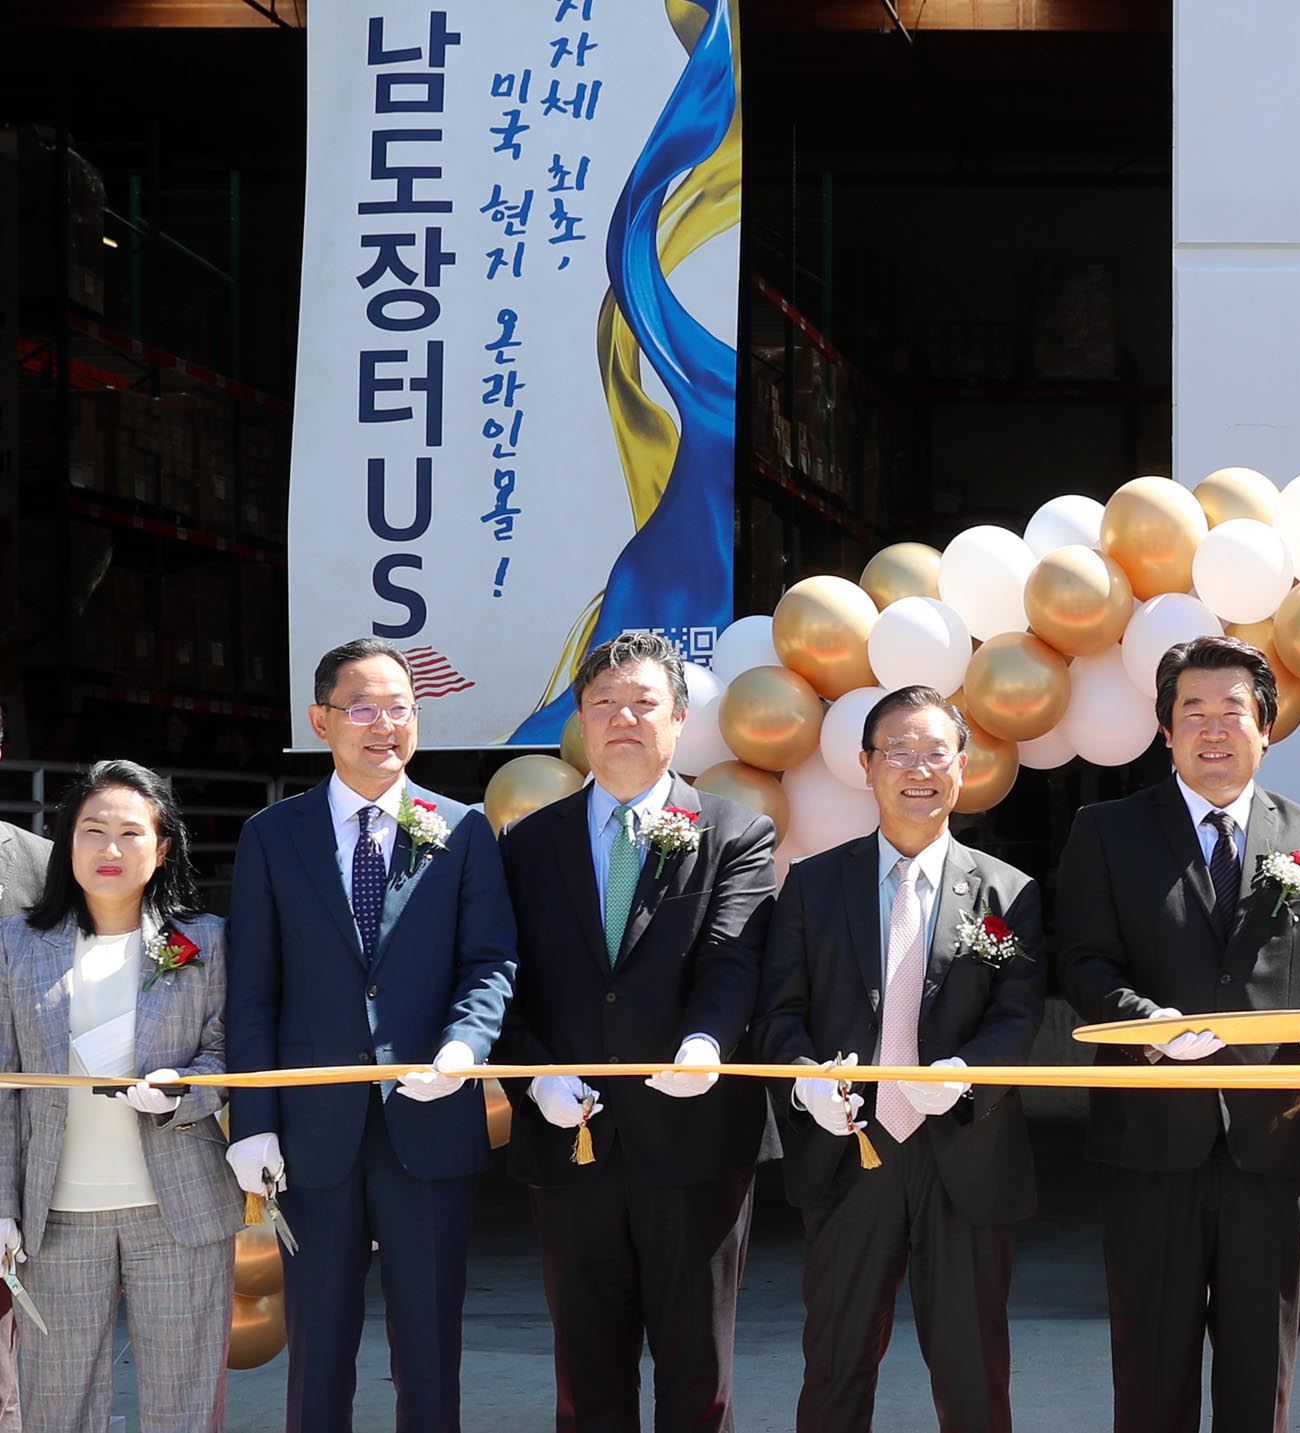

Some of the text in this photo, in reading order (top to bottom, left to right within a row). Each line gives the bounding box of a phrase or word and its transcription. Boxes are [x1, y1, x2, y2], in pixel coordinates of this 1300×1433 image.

[490, 69, 531, 160] 미국
[480, 184, 534, 280] 현지
[547, 154, 589, 270] 최초,
[357, 11, 461, 639] 남도장터 US
